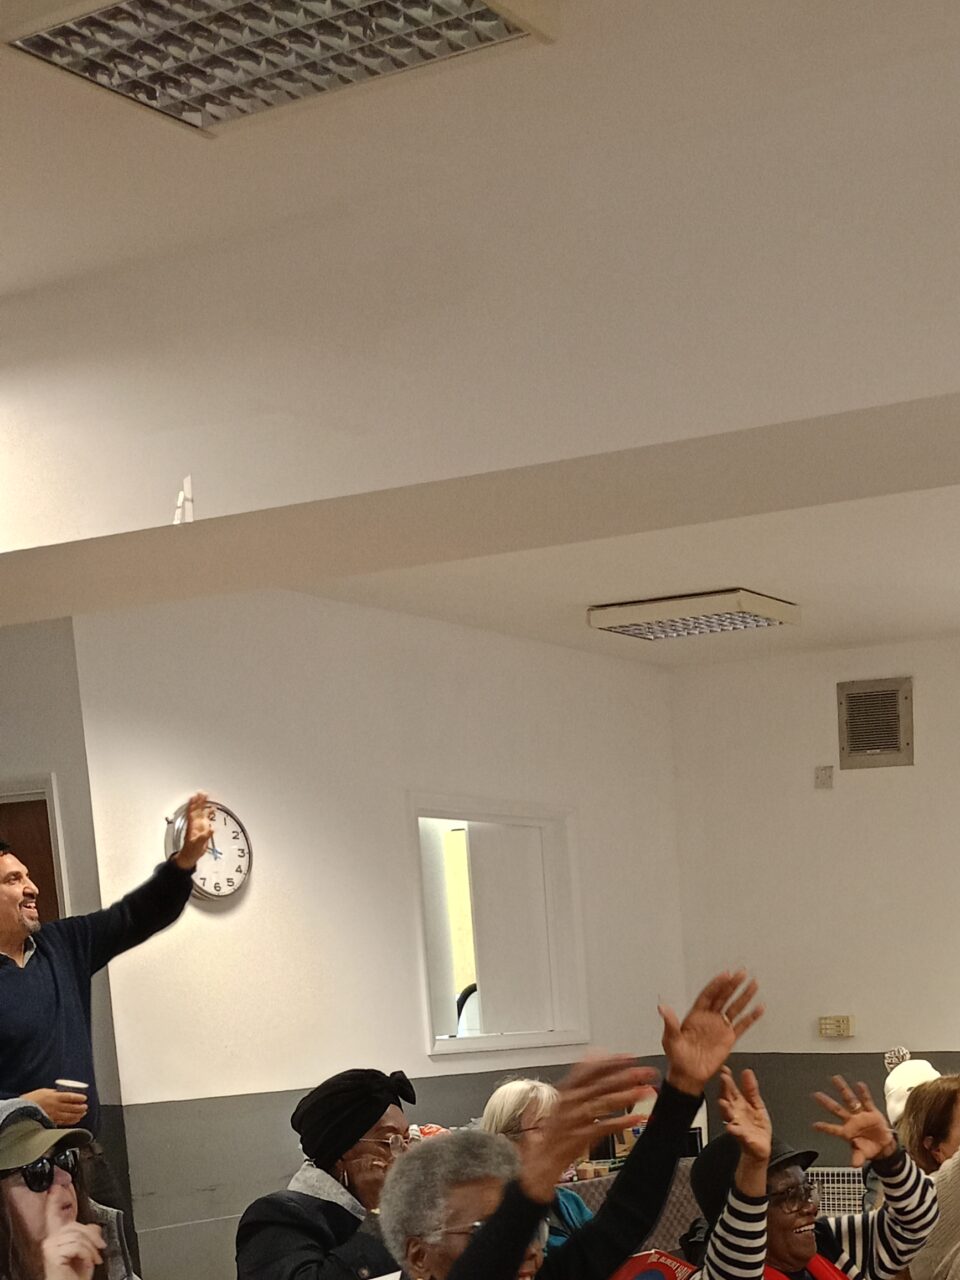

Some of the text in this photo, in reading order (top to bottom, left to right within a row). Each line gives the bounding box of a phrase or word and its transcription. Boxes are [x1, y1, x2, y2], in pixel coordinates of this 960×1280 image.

[232, 831, 240, 840] 2
[238, 849, 246, 858] 3
[235, 865, 243, 874] 4
[226, 878, 235, 887] 5
[213, 883, 221, 892] 6
